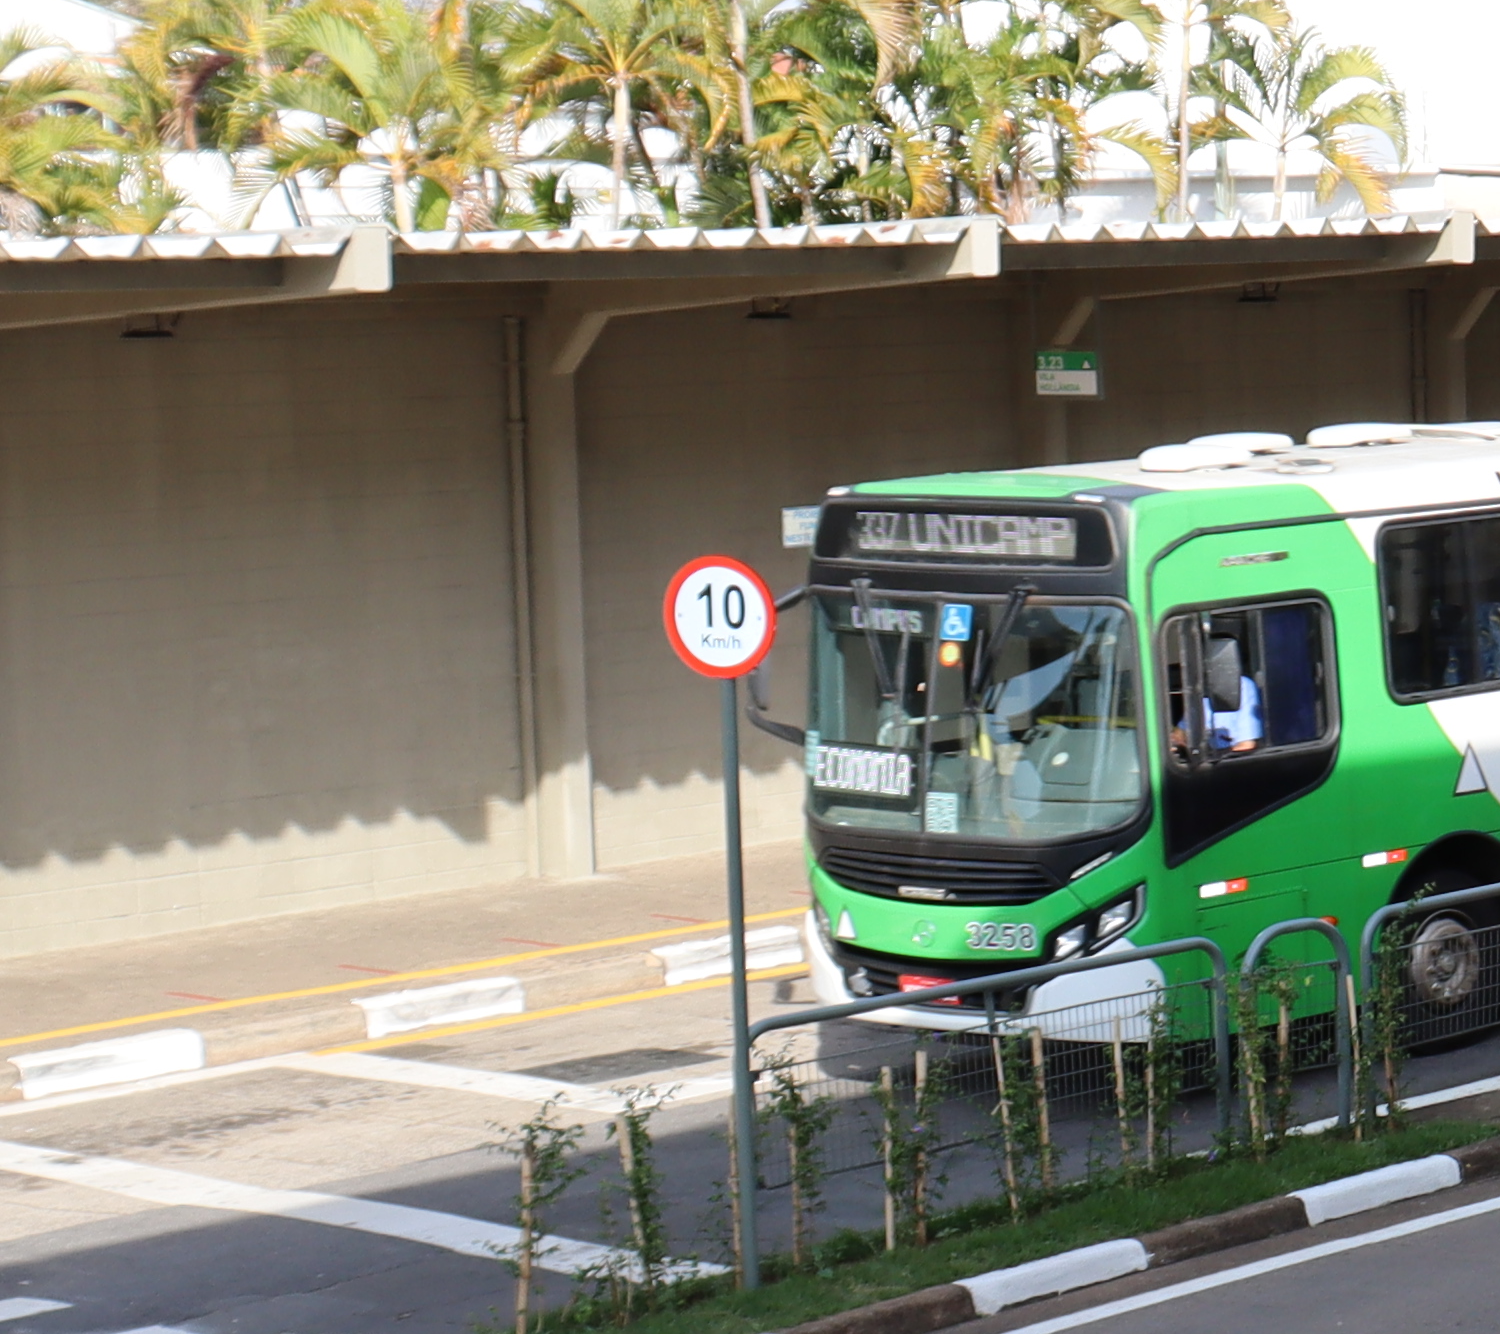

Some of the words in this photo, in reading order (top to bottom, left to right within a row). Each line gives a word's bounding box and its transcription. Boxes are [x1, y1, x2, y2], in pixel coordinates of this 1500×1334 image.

[1037, 355, 1064, 370] 3.23
[907, 513, 1077, 557] UNICAMP
[697, 583, 747, 630] 10
[701, 633, 742, 650] Km/h
[965, 921, 1037, 951] 3258
